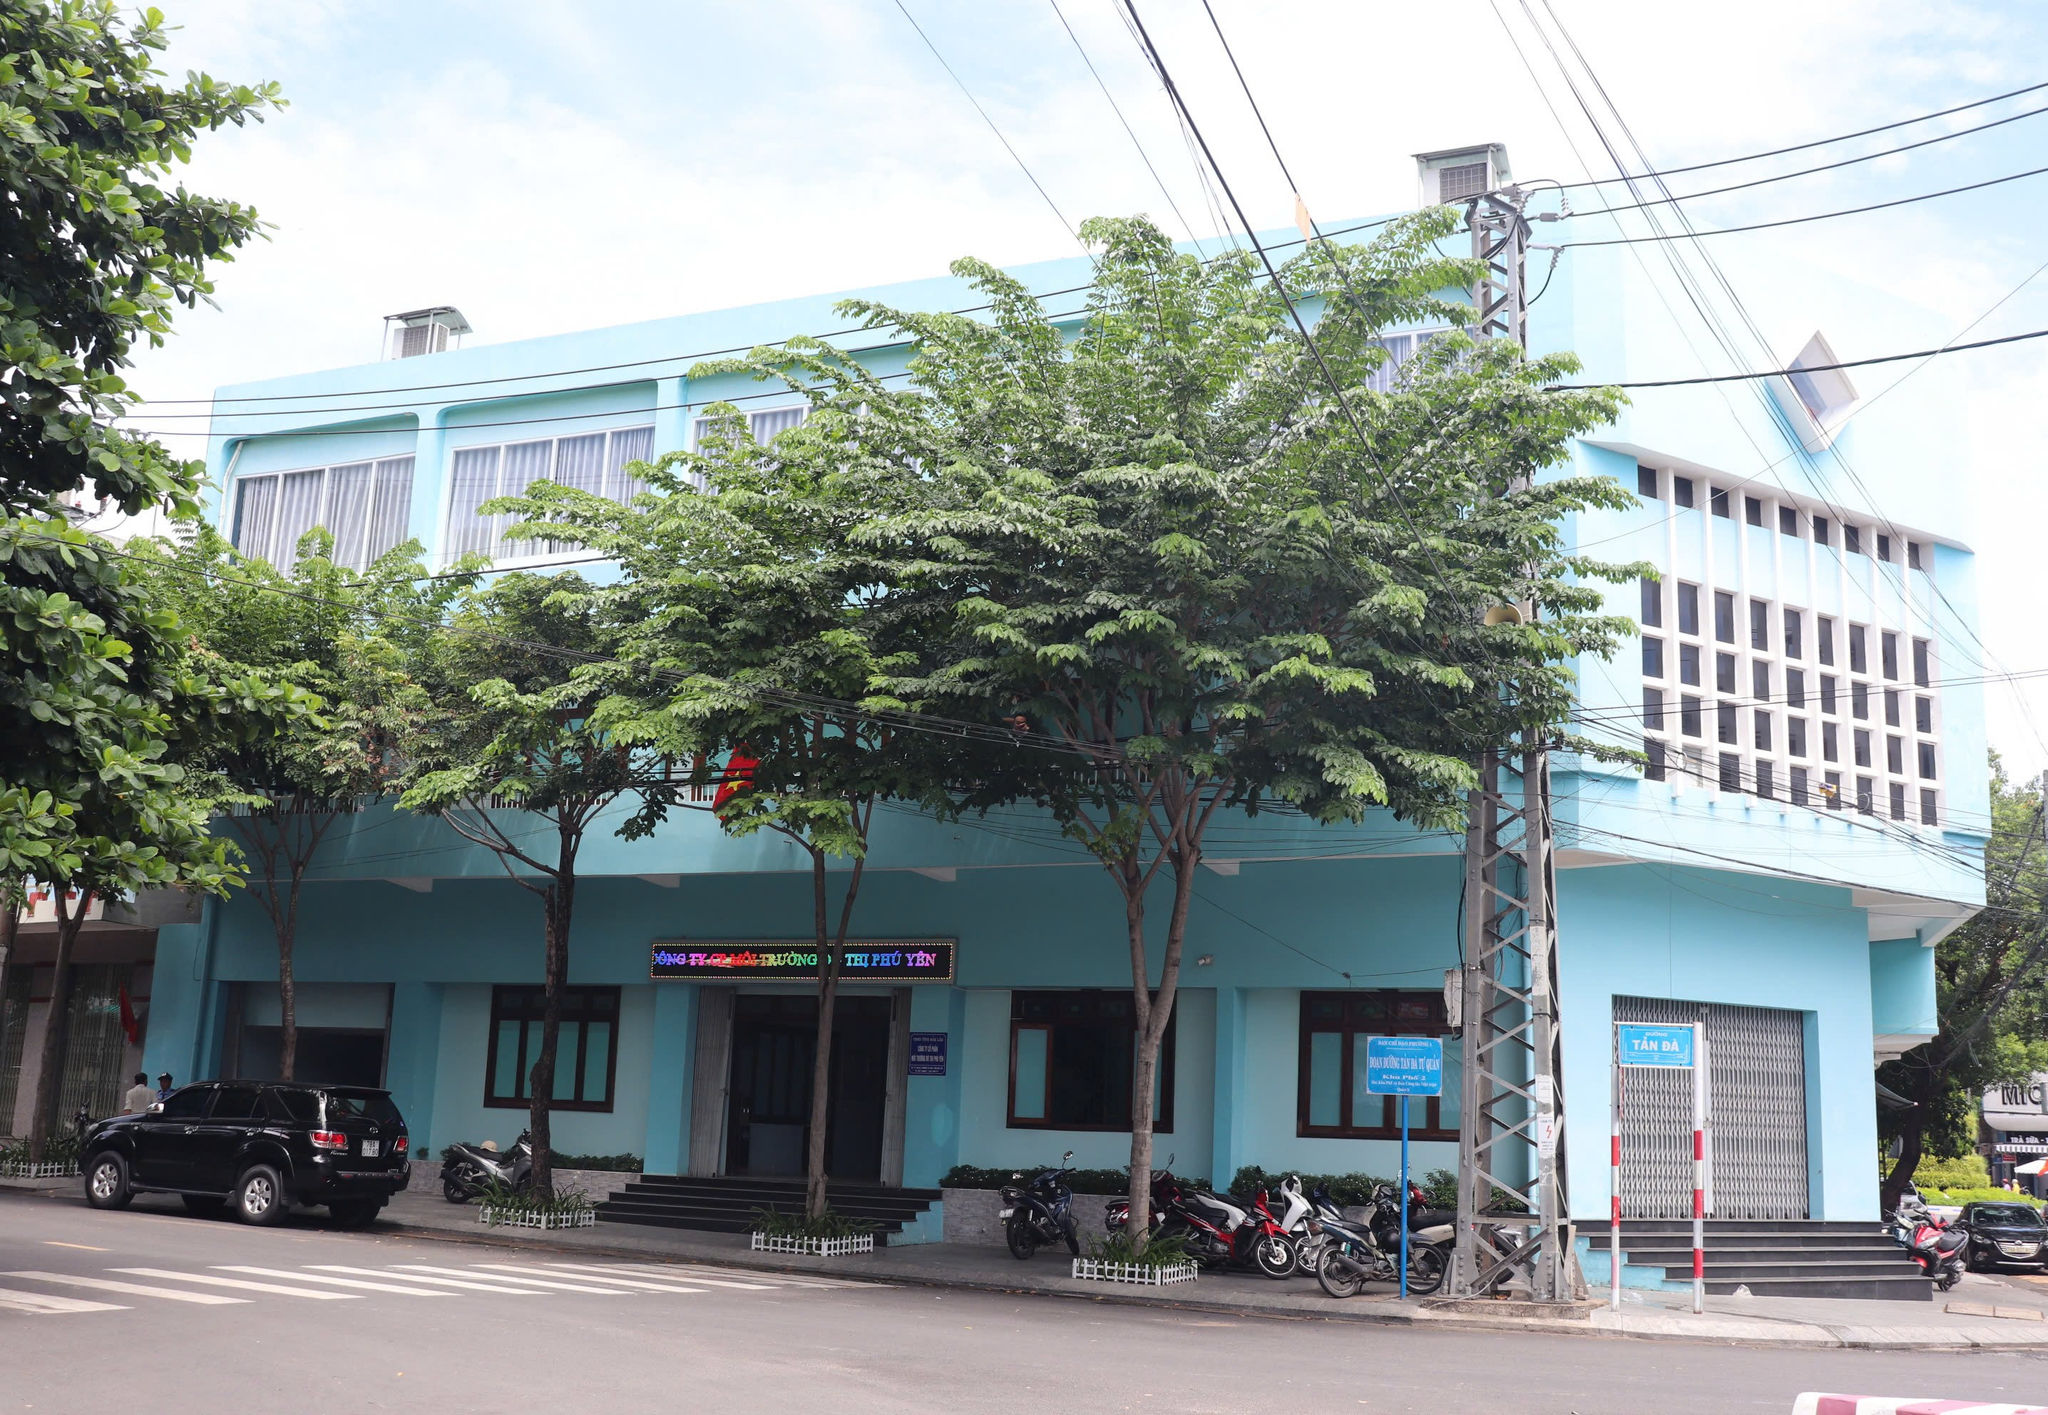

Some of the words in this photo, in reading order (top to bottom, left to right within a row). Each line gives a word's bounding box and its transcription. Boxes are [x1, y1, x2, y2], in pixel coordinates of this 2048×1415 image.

[689, 953, 707, 966] TY
[759, 951, 818, 967] TRƯỜNG
[844, 953, 869, 968] THỊ
[871, 950, 902, 967] PHÚ
[905, 950, 937, 967] YÊN
[1631, 1036, 1658, 1051] TẢN
[1662, 1038, 1679, 1052] ĐÀ
